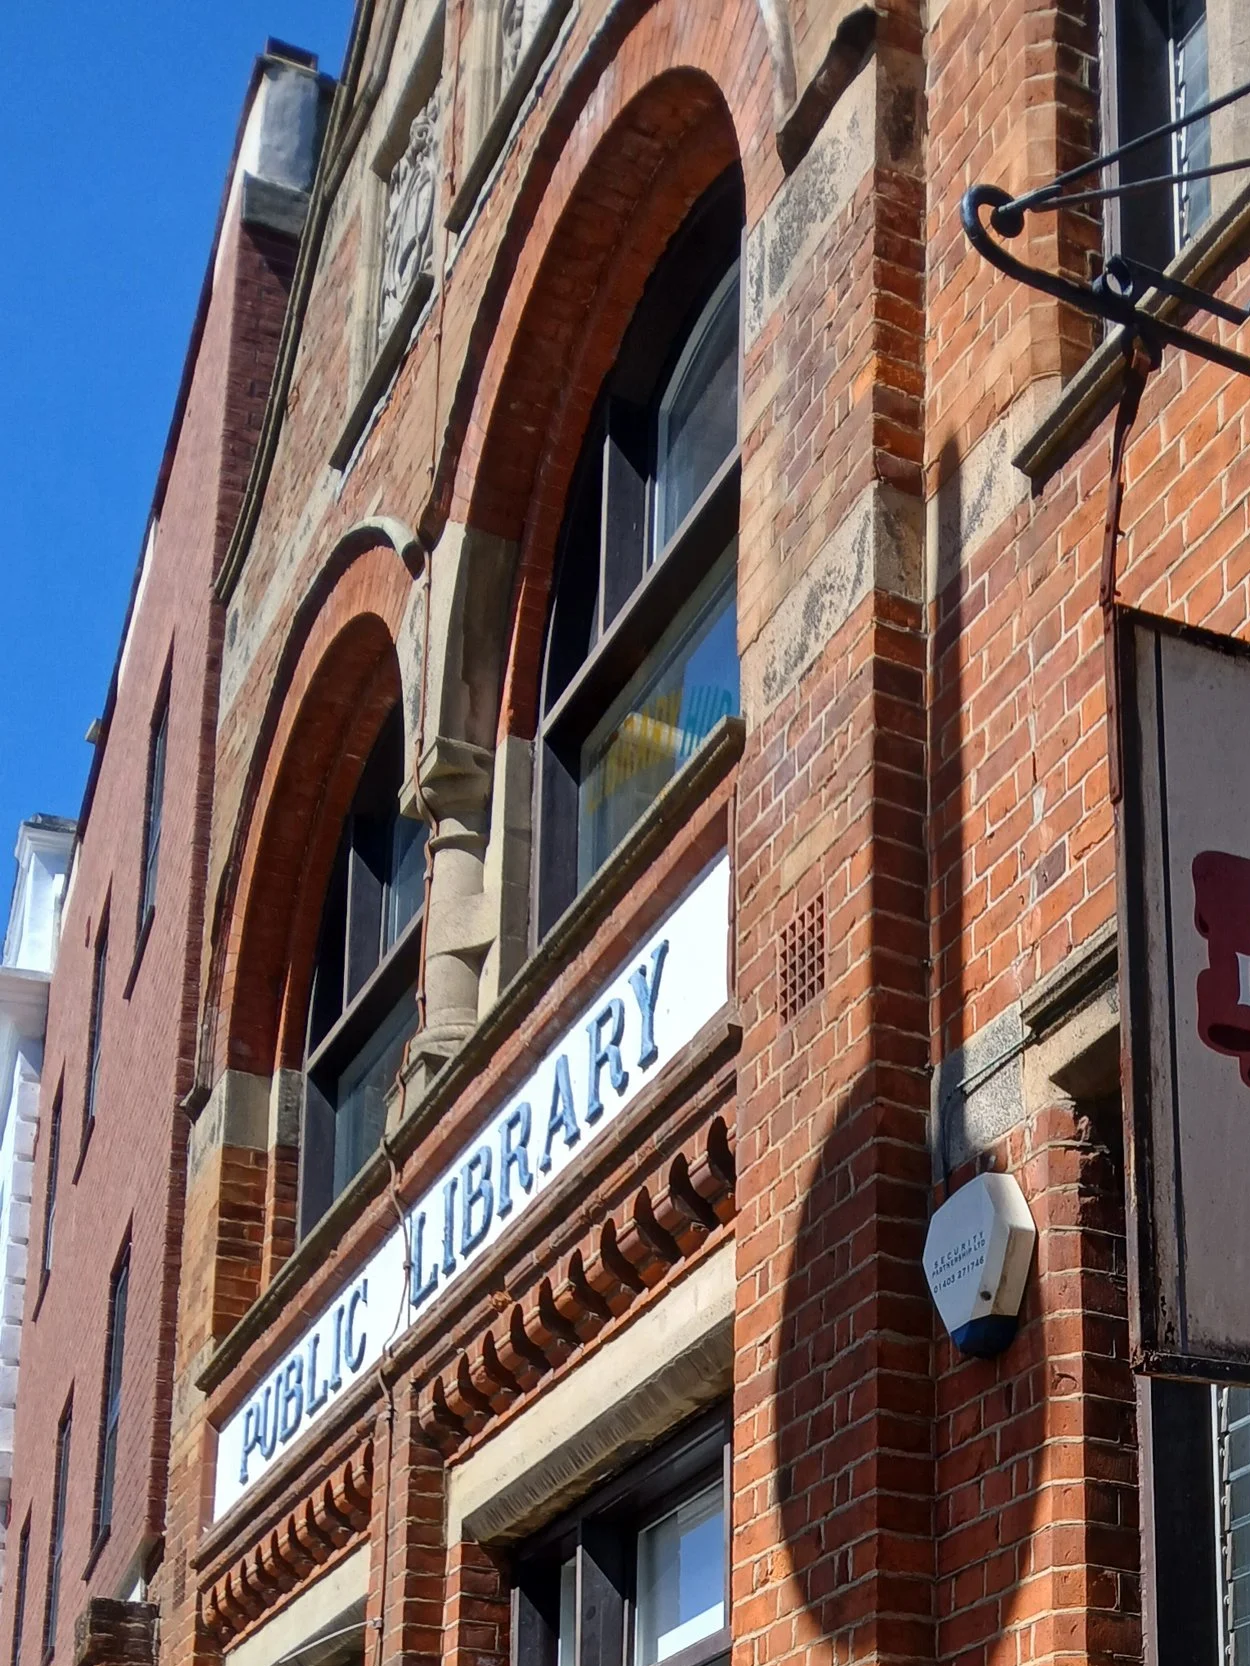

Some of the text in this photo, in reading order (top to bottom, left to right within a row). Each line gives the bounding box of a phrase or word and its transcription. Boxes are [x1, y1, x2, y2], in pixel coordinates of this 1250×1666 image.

[238, 939, 669, 1484] PUBLIC LIBRARY
[932, 1239, 985, 1278] PARTNERSHIP LTD
[934, 1231, 983, 1269] SECURITY
[933, 1256, 985, 1293] 01403 271746
